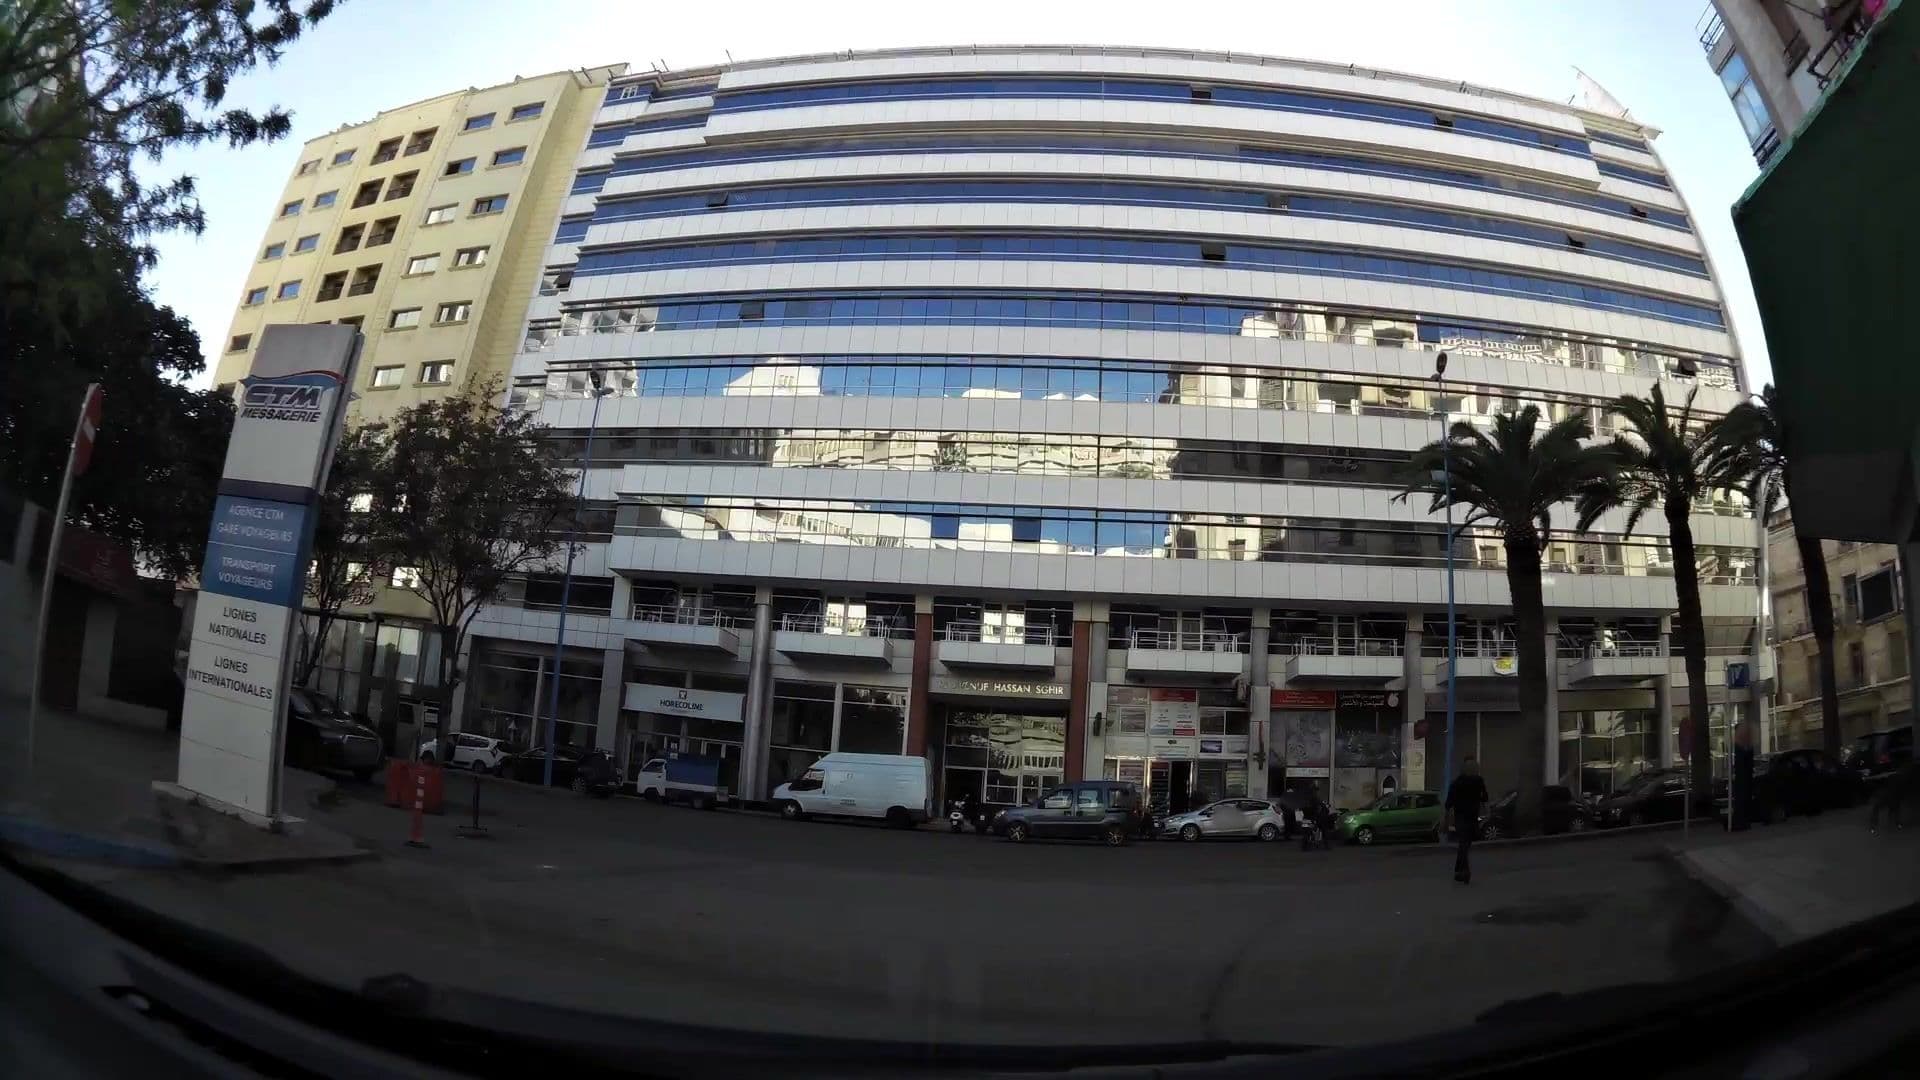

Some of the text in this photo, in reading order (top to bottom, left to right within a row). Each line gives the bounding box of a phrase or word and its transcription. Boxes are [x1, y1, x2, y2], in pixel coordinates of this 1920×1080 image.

[243, 384, 324, 410] CTM
[241, 408, 321, 423] MESSAGERIE
[228, 504, 284, 521] AGENCE CTM
[216, 522, 294, 542] GARE VOYAGEURS
[222, 556, 277, 574] TRANSPORT
[218, 571, 273, 590] VOYAGEURS
[223, 607, 257, 622] LIGNES
[209, 622, 267, 644] NATIONALES
[214, 656, 248, 673] LIGNES
[188, 668, 273, 700] INTERNATIONALES
[993, 683, 1031, 693] HASSAN
[1035, 685, 1064, 695] SGHIR
[659, 699, 704, 711] HORECOLINE
